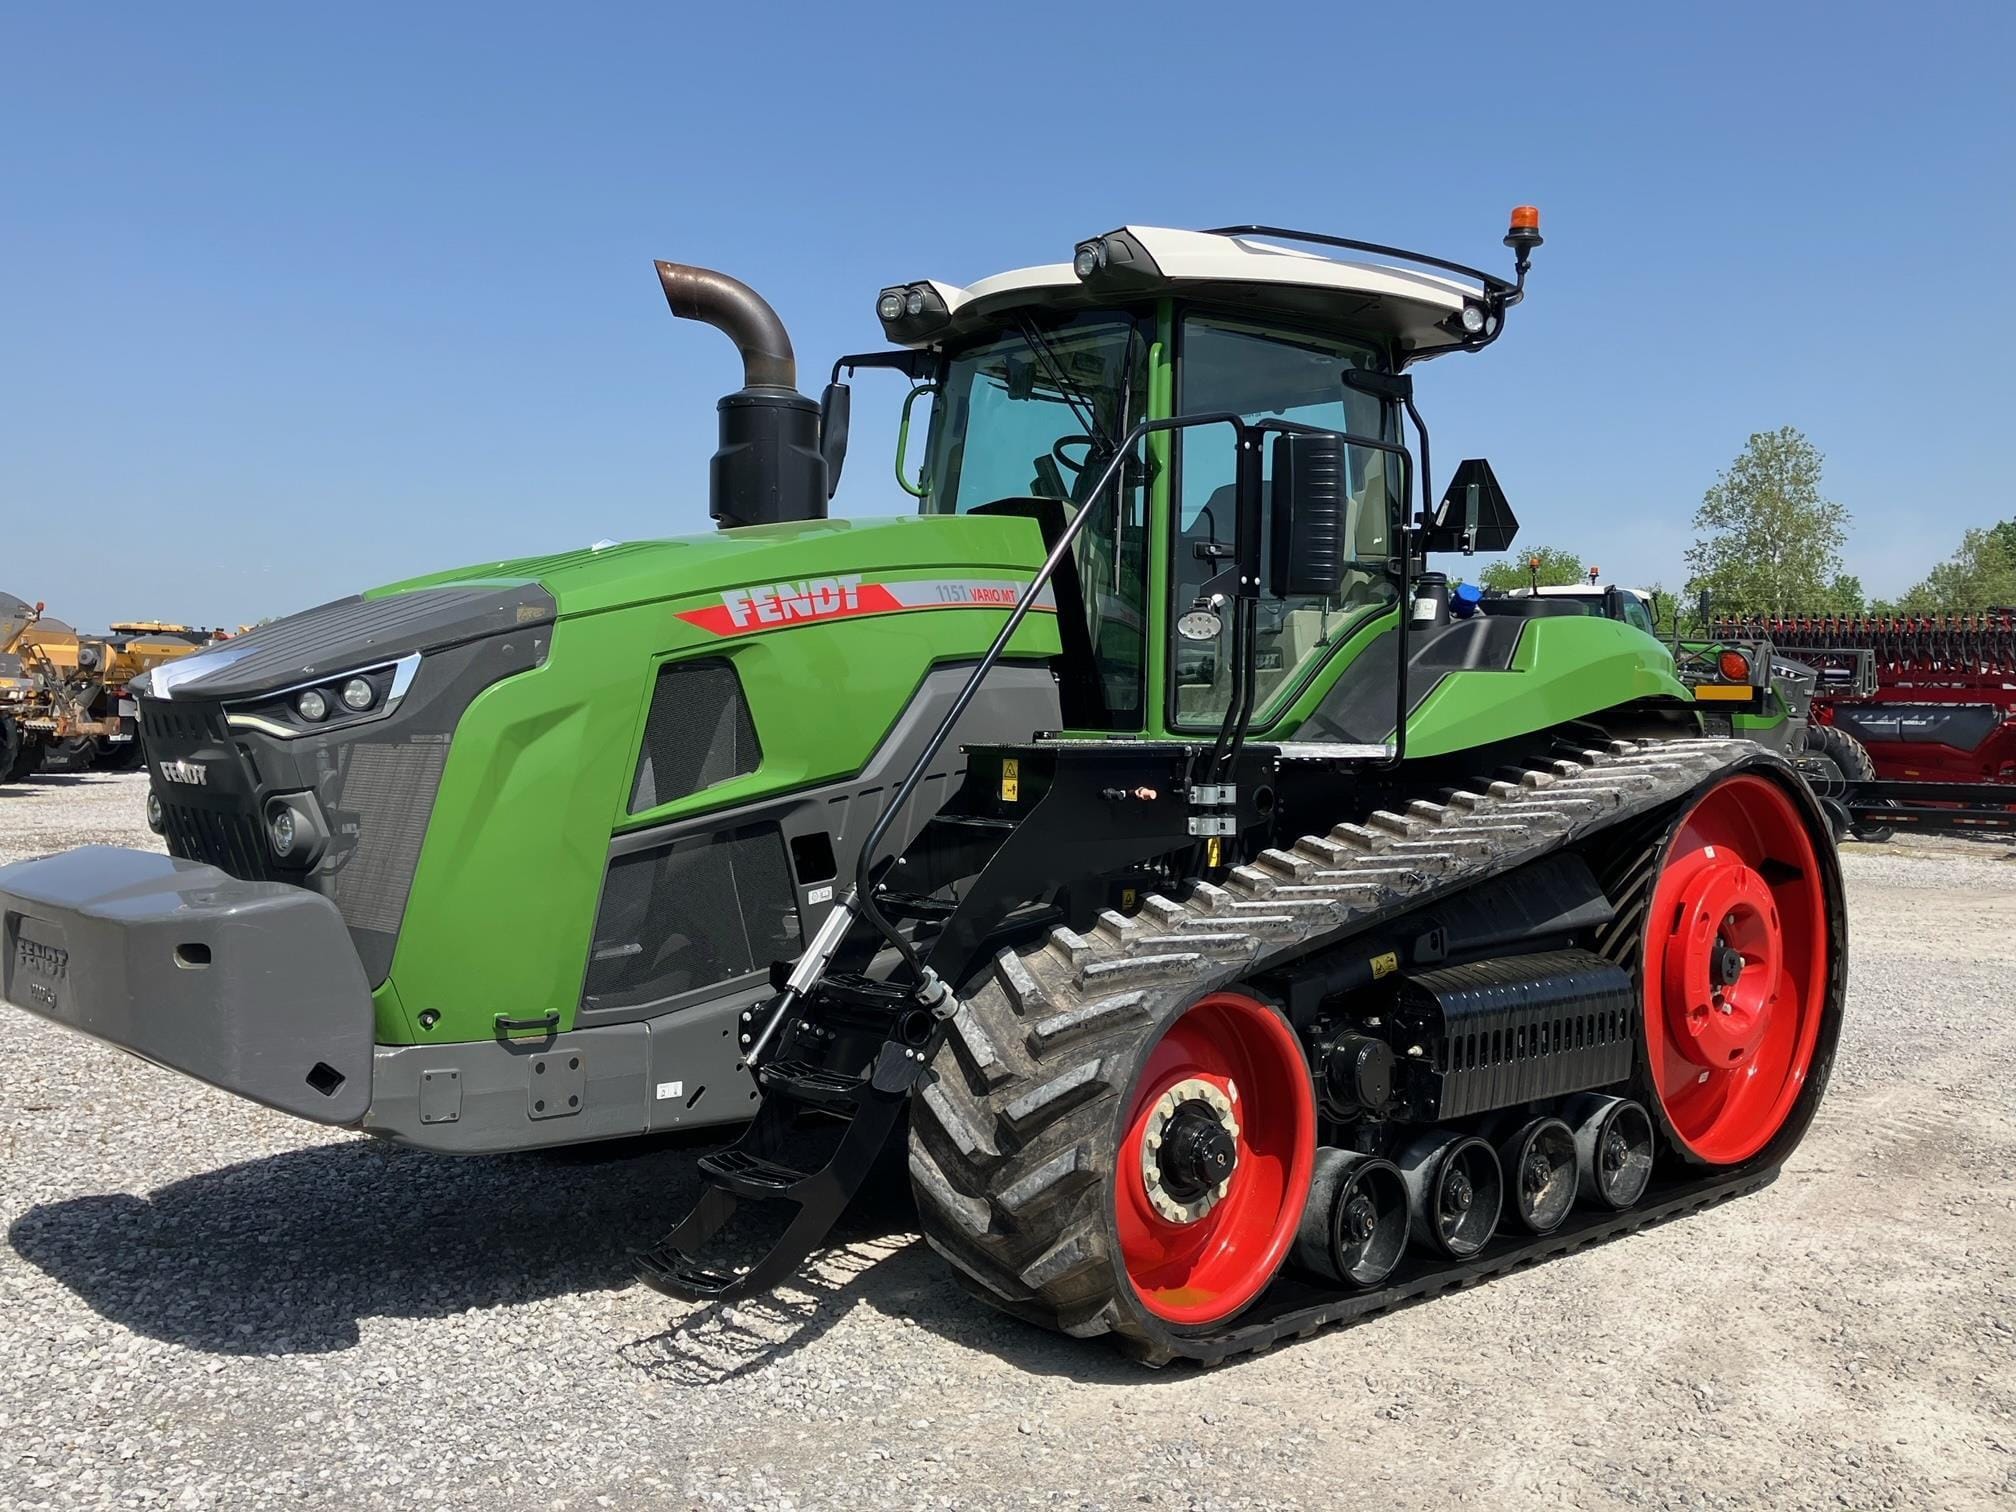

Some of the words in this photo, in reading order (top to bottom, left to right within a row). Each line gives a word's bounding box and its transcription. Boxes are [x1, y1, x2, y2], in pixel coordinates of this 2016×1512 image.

[719, 573, 863, 628] FENDT
[936, 583, 967, 603] 1151
[969, 587, 1000, 603] VARIO
[1001, 589, 1016, 603] MT
[160, 760, 207, 786] FENDT
[17, 938, 68, 979] FENDT
